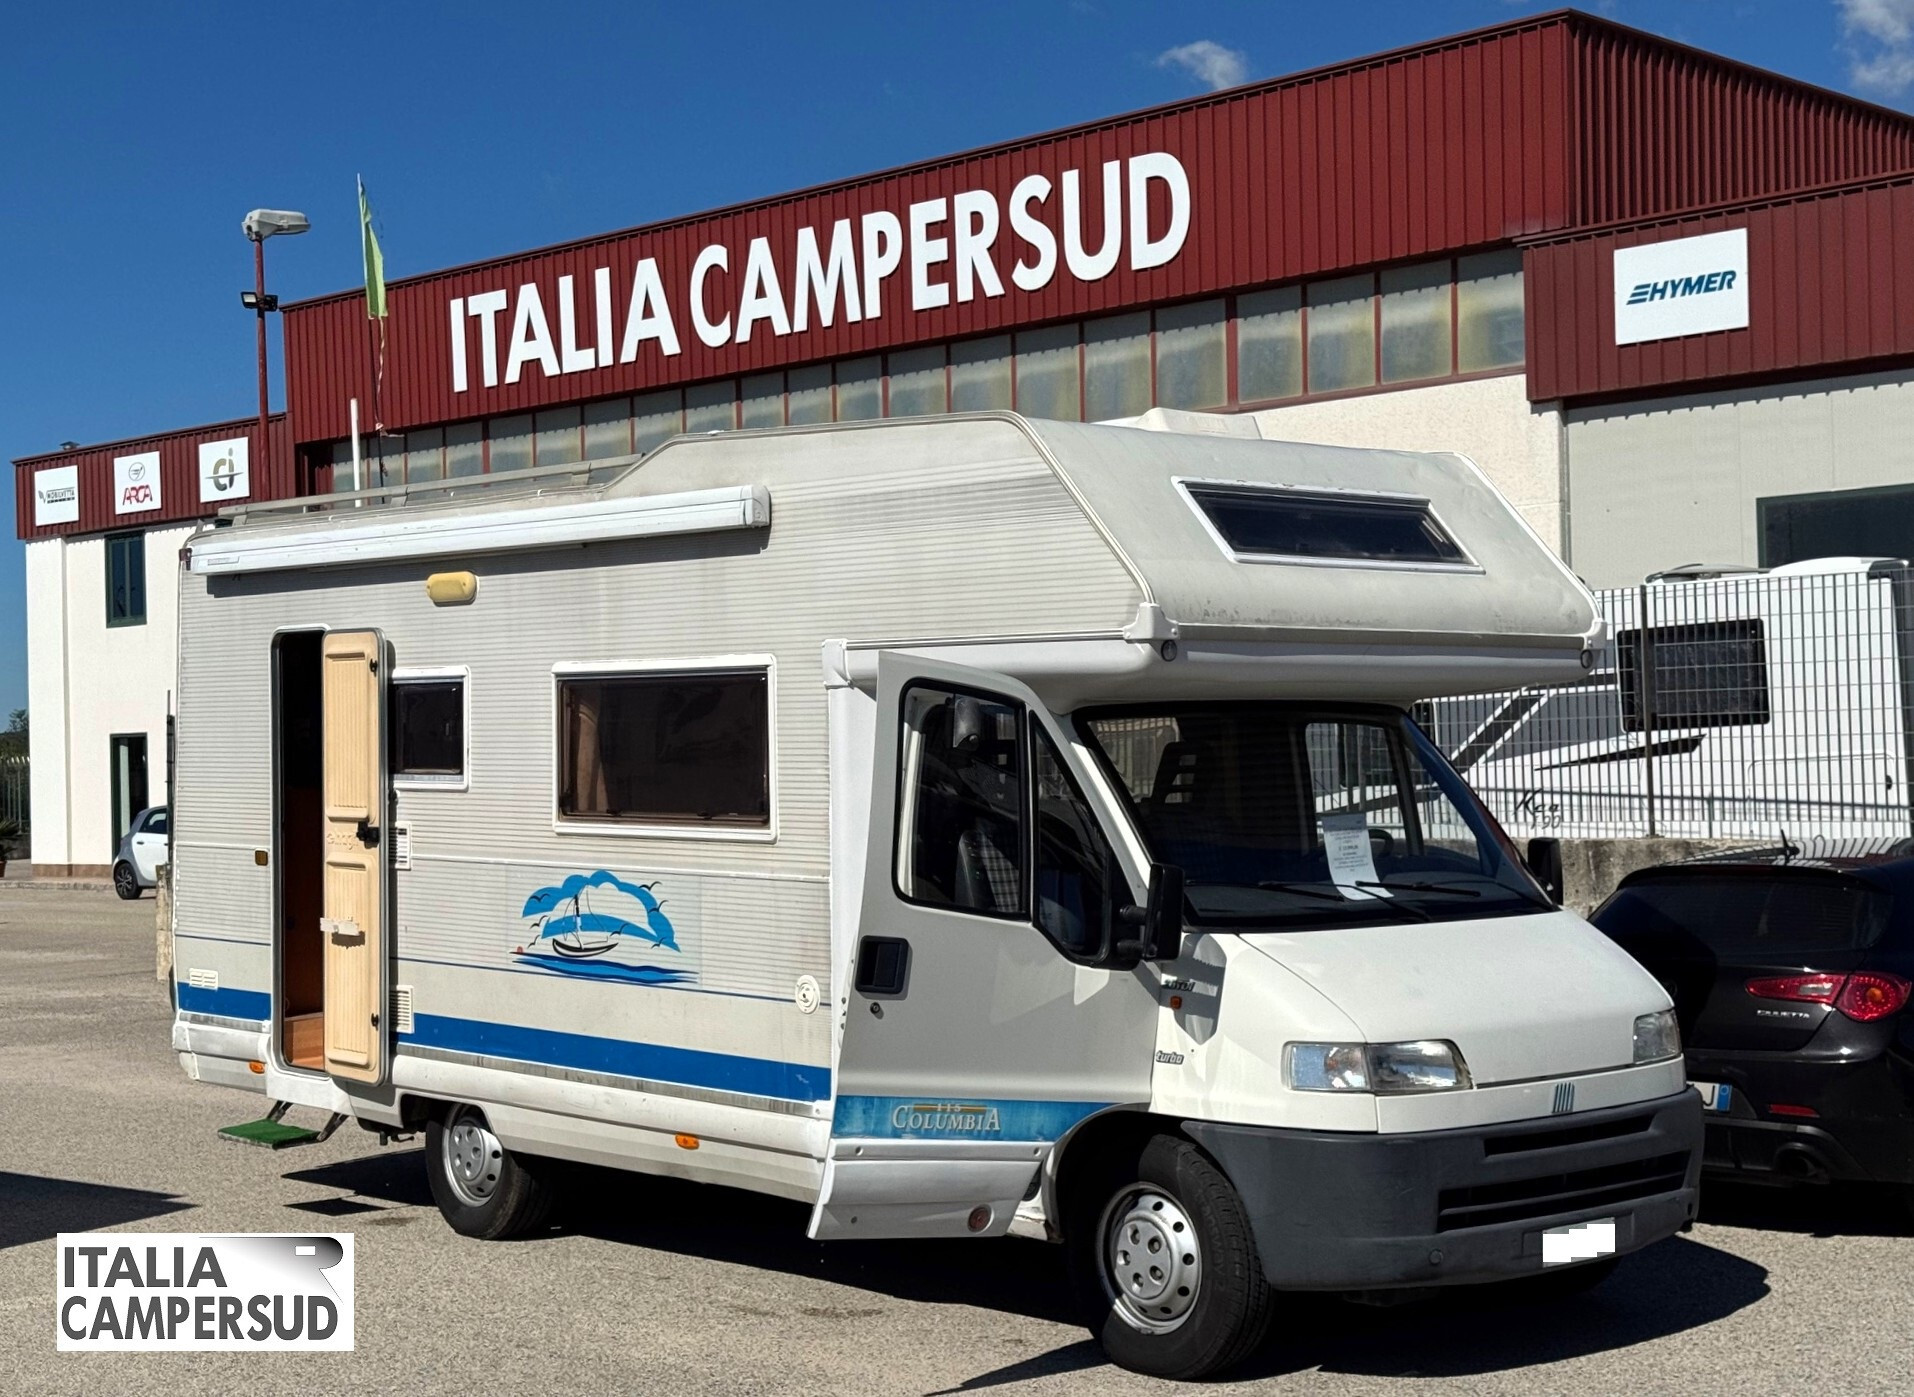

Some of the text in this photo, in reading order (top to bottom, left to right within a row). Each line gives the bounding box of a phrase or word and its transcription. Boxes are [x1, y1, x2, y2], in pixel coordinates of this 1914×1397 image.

[449, 152, 1192, 393] ITALIA CAMPERSUD
[1648, 269, 1737, 302] HYMER
[122, 484, 153, 506] ARCA
[1155, 1050, 1185, 1065] turbo
[936, 1103, 962, 1113] 115
